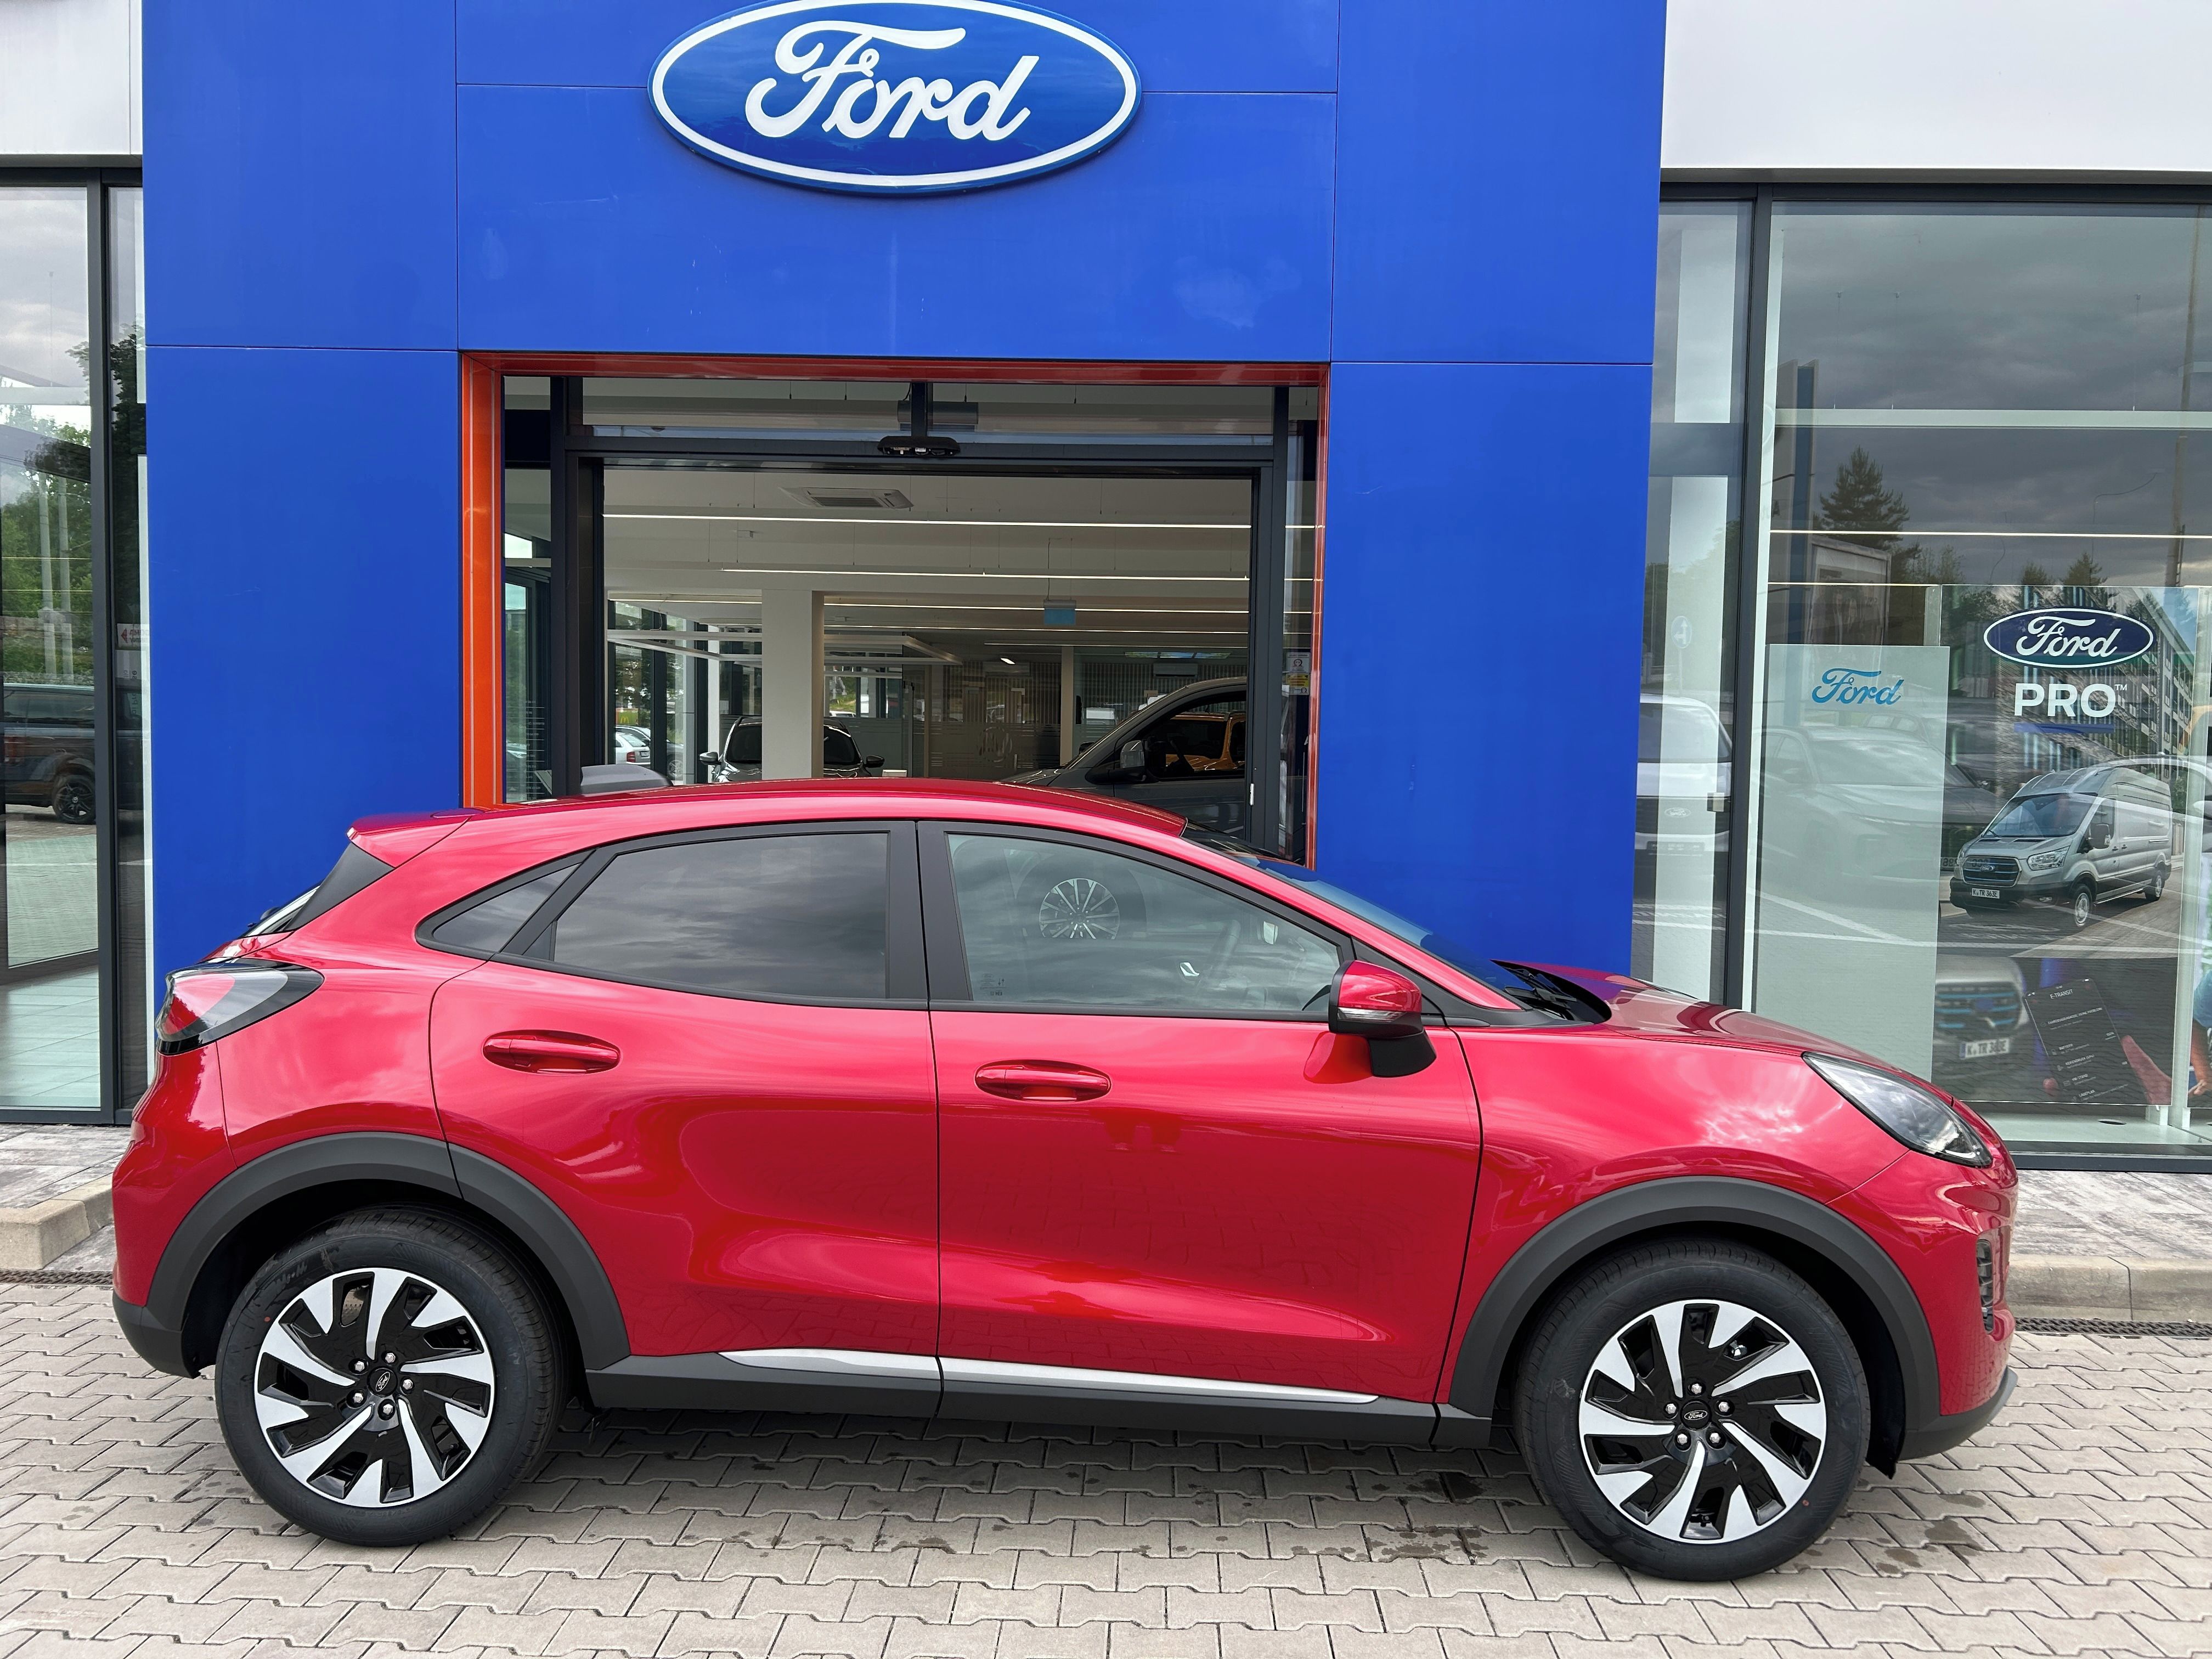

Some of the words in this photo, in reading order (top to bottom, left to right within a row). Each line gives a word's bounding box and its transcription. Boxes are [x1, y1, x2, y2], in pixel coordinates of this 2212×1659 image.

[746, 20, 1040, 141] Ford
[2016, 616, 2120, 658] Ford
[1812, 668, 1905, 706] Ford
[2050, 989, 2073, 999] E-TRANSIT
